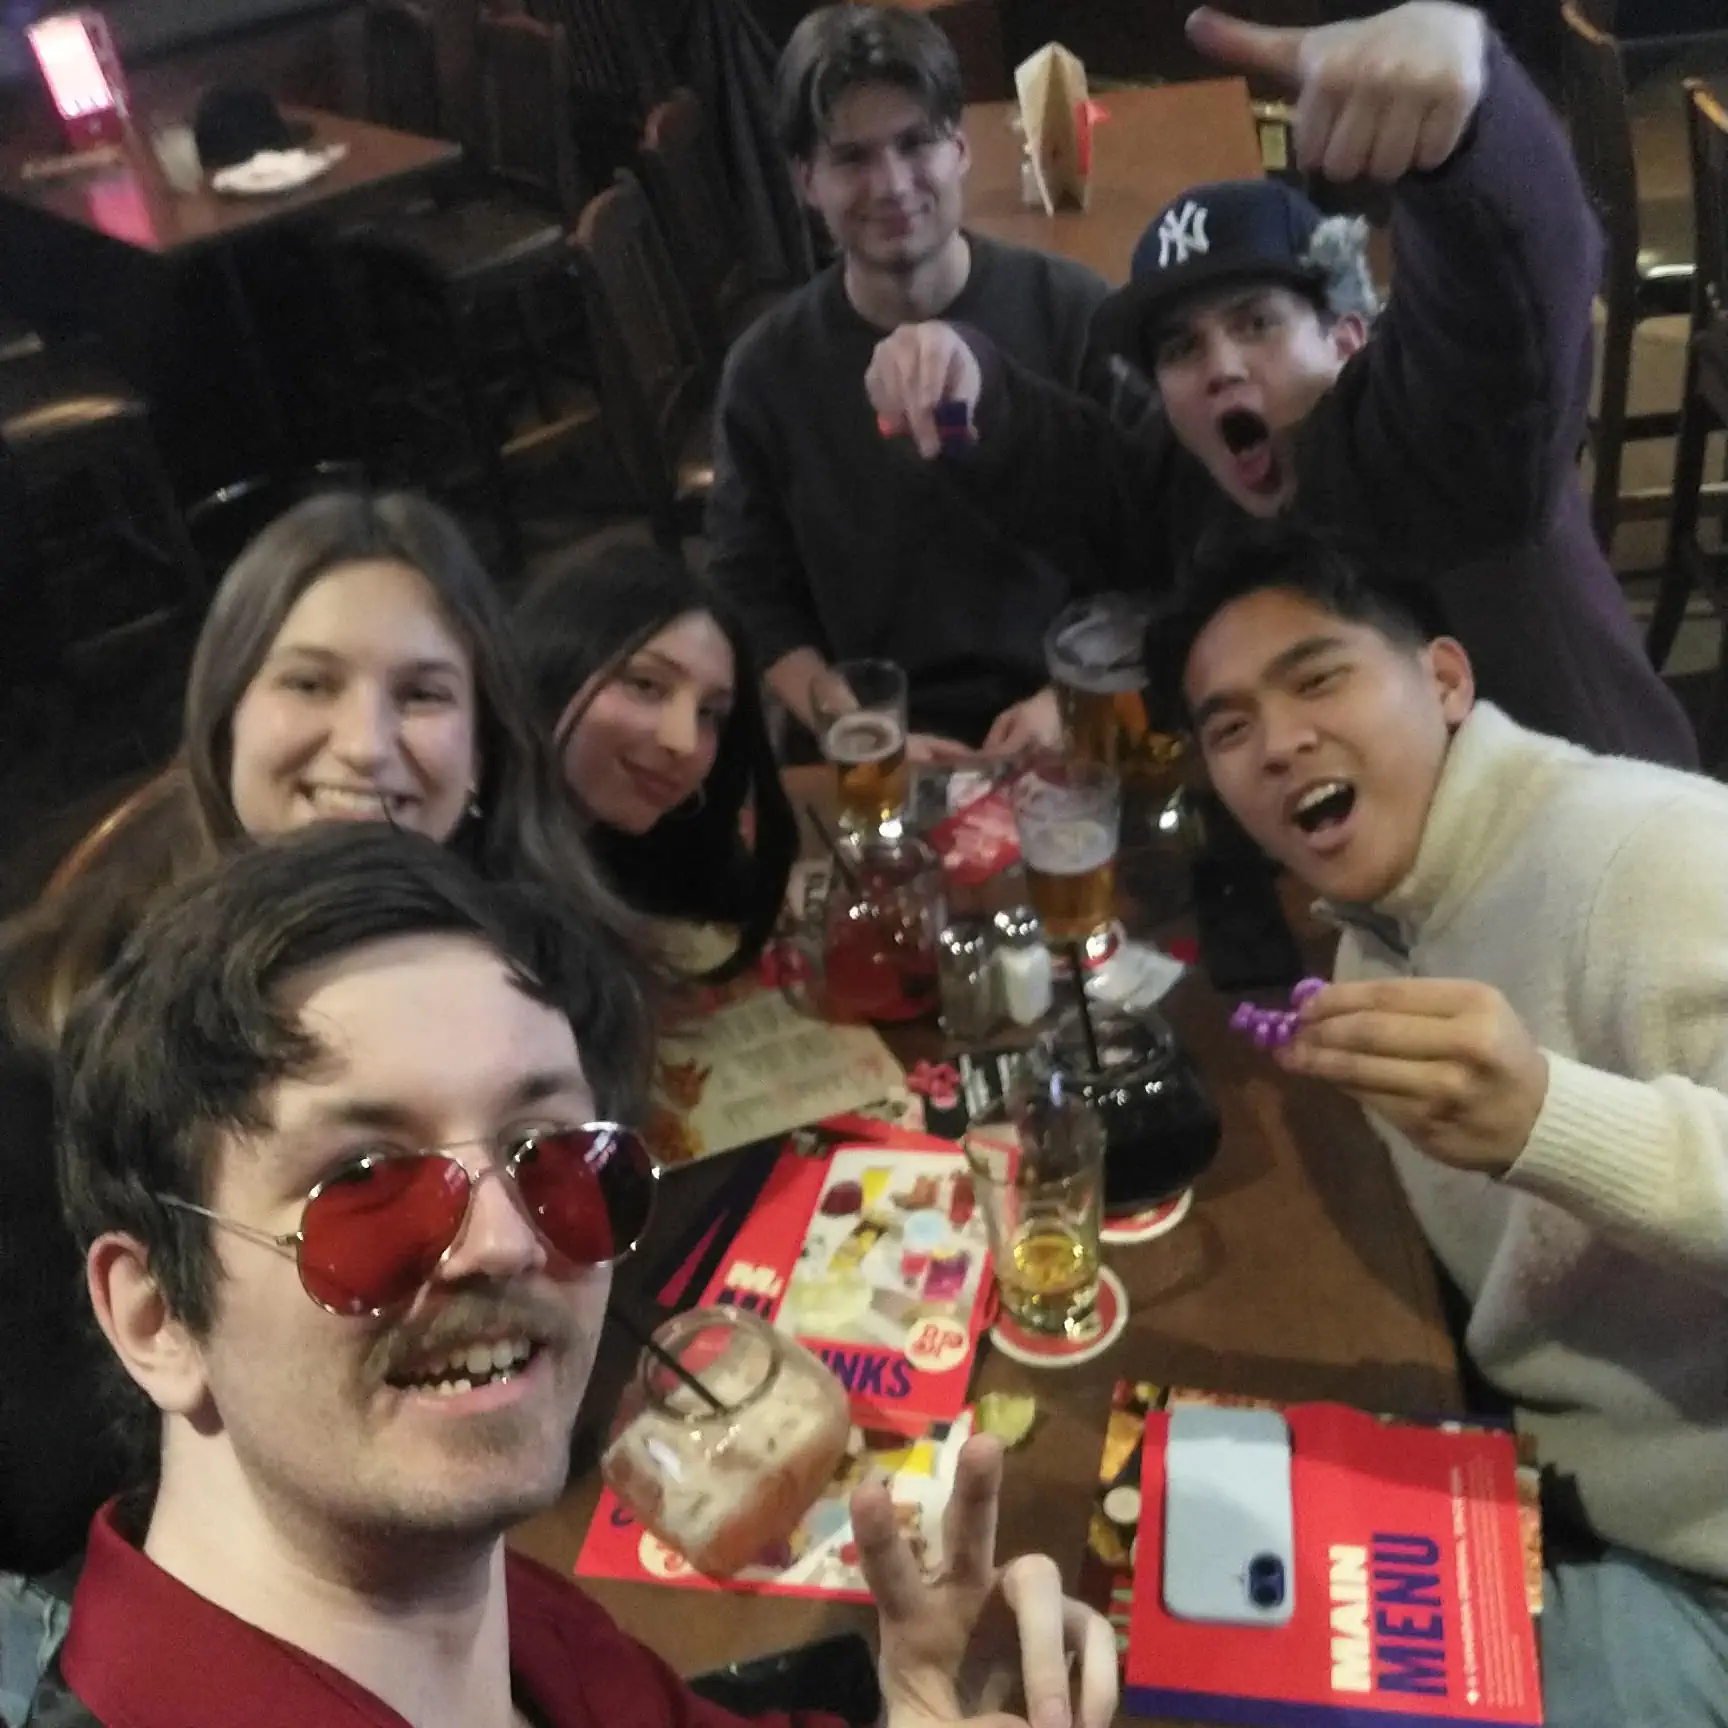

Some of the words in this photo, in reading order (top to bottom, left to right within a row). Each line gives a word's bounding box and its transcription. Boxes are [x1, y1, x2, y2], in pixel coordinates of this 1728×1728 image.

[1158, 200, 1210, 268] NY
[1329, 1544, 1371, 1694] MAIN
[1373, 1533, 1449, 1697] MENU
